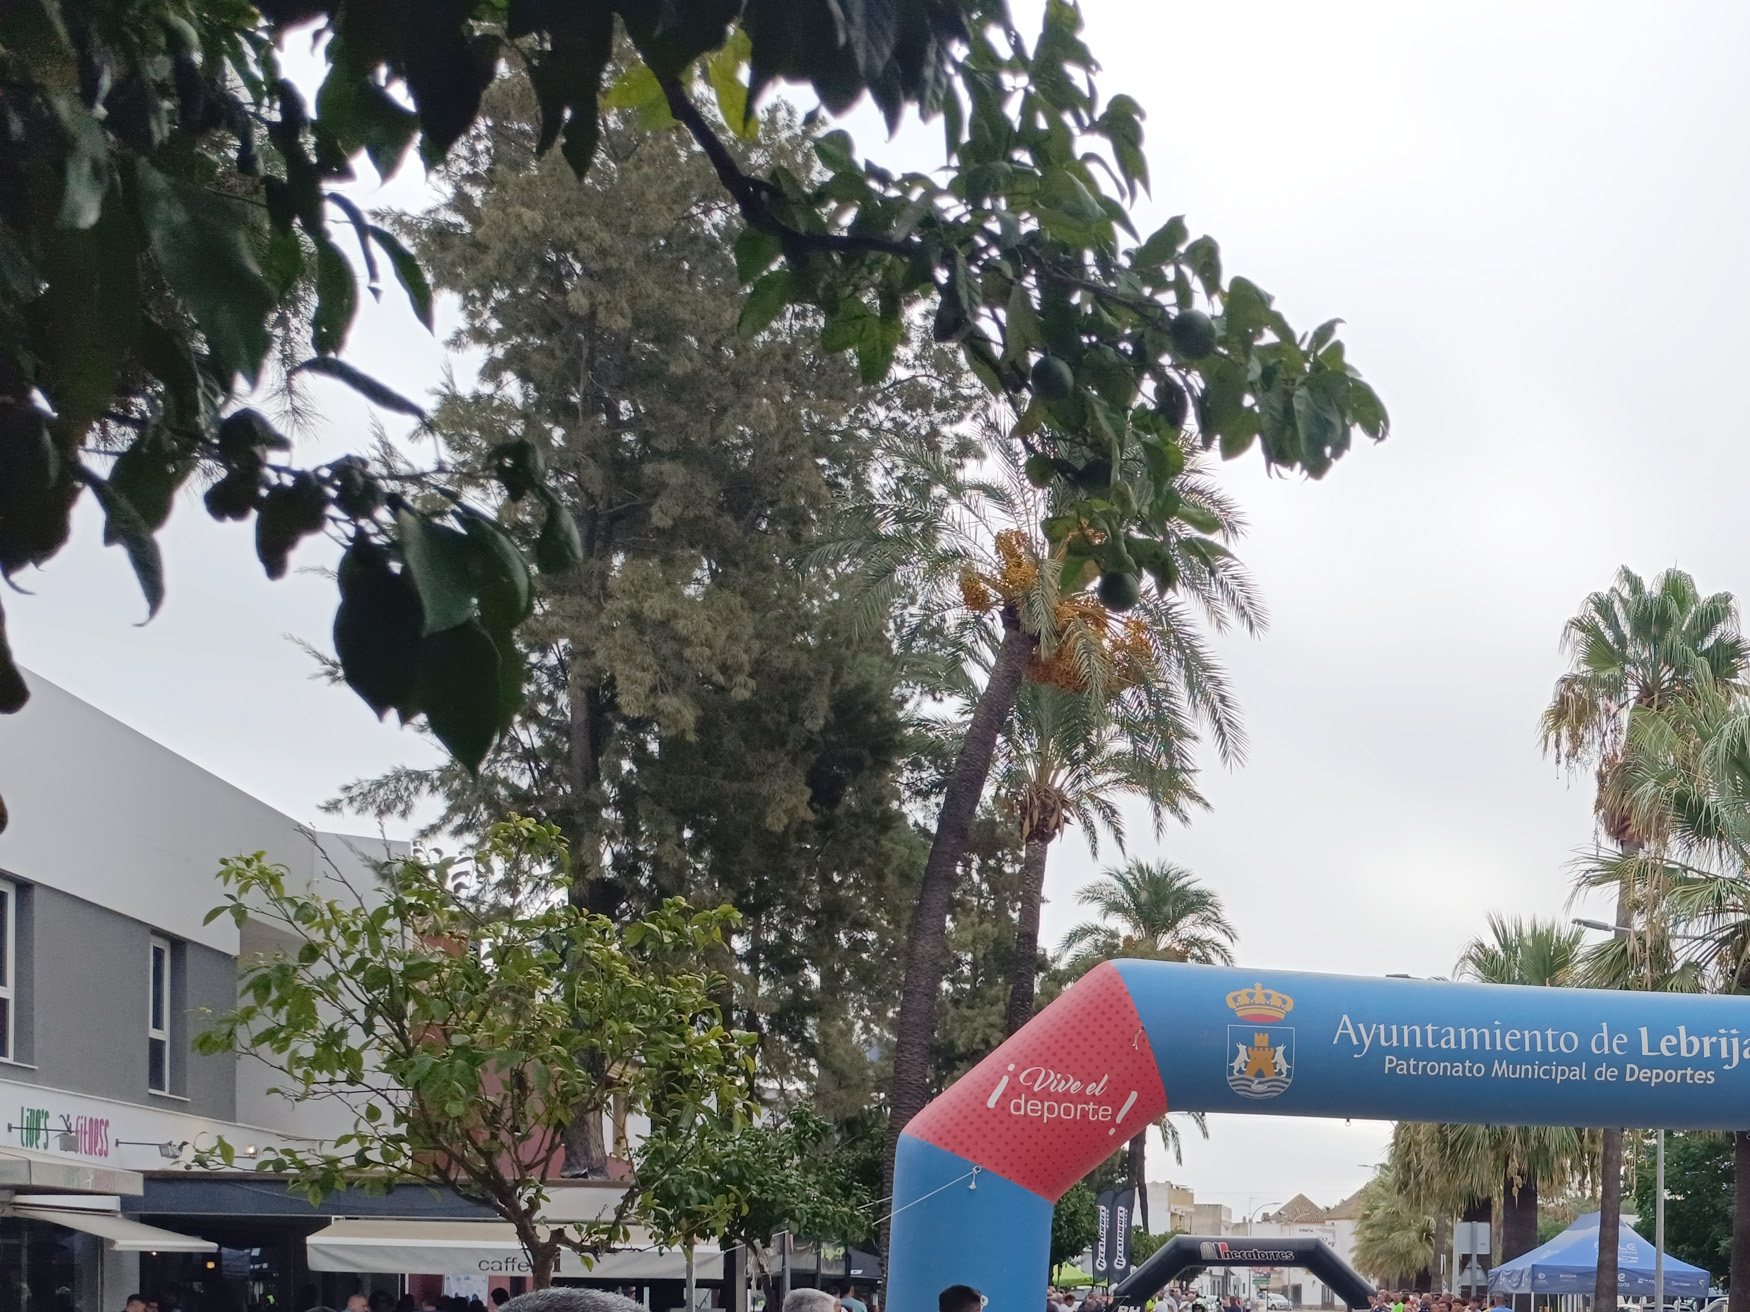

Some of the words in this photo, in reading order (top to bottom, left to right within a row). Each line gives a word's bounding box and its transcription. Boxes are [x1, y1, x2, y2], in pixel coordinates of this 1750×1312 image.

[1333, 1014, 1579, 1058] Ayuntamiento
[1590, 1021, 1629, 1055] de
[1384, 1055, 1485, 1078] Patronato
[1491, 1058, 1588, 1083] Municipal
[1593, 1062, 1618, 1082] de
[1625, 1063, 1716, 1085] Deportes
[1086, 1074, 1108, 1096] el
[1223, 1248, 1295, 1261] necatorres
